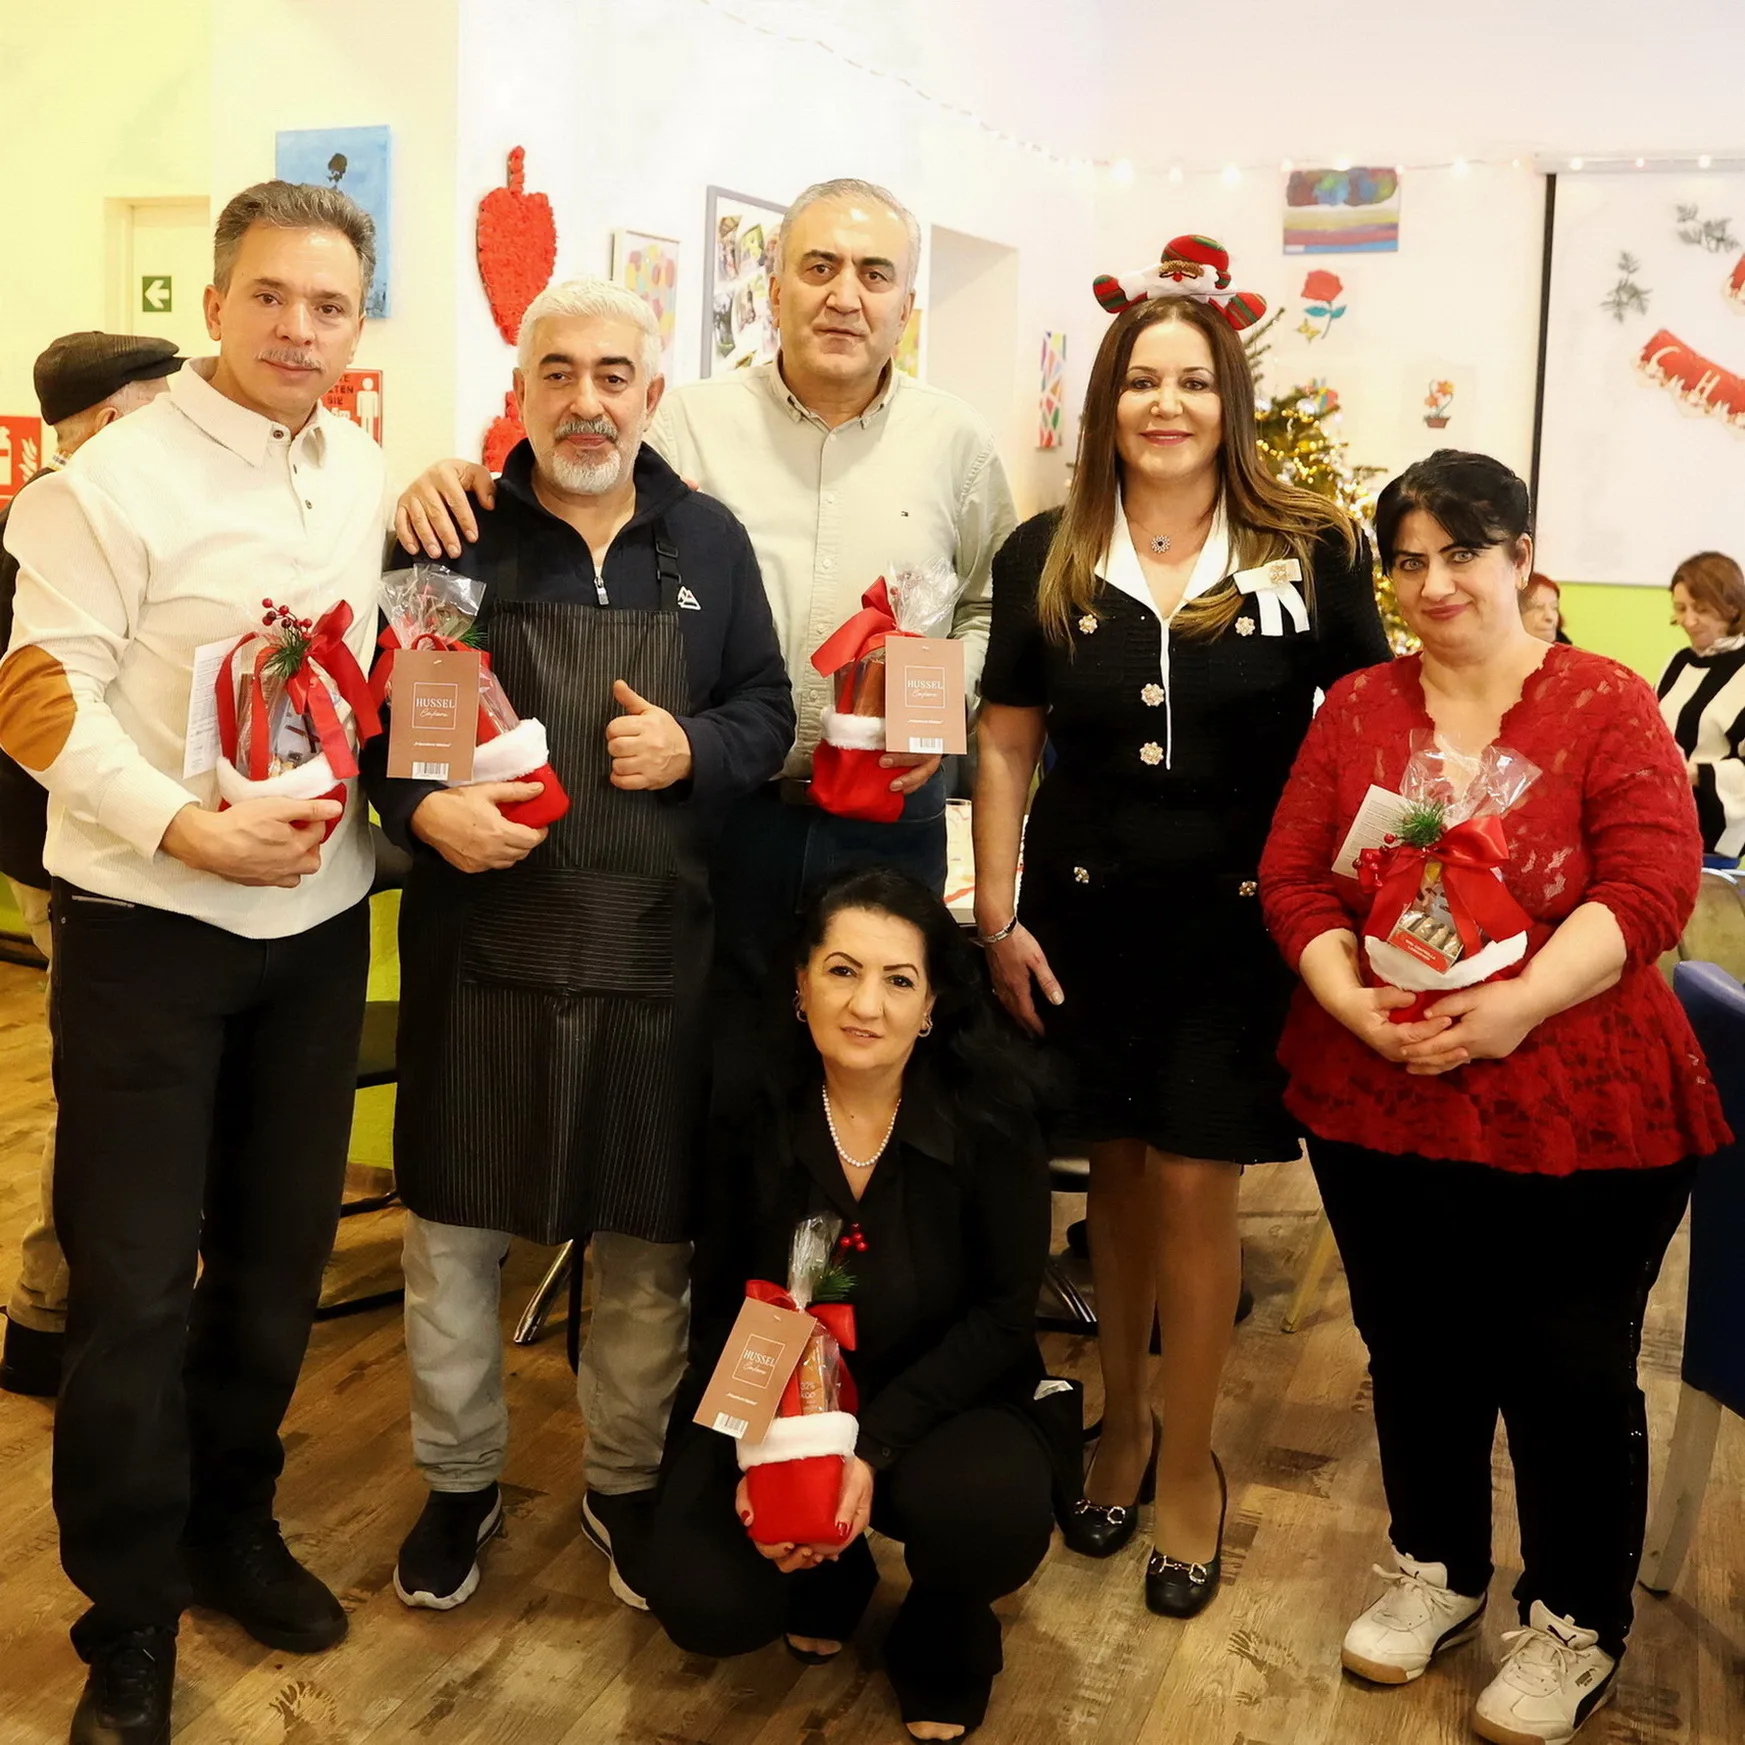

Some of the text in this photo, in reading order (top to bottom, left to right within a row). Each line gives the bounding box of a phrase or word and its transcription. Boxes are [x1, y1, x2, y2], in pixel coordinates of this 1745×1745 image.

[907, 680, 943, 690] HUSSEL
[416, 698, 455, 709] HUSSEL
[743, 1349, 776, 1367] HUSSEL
